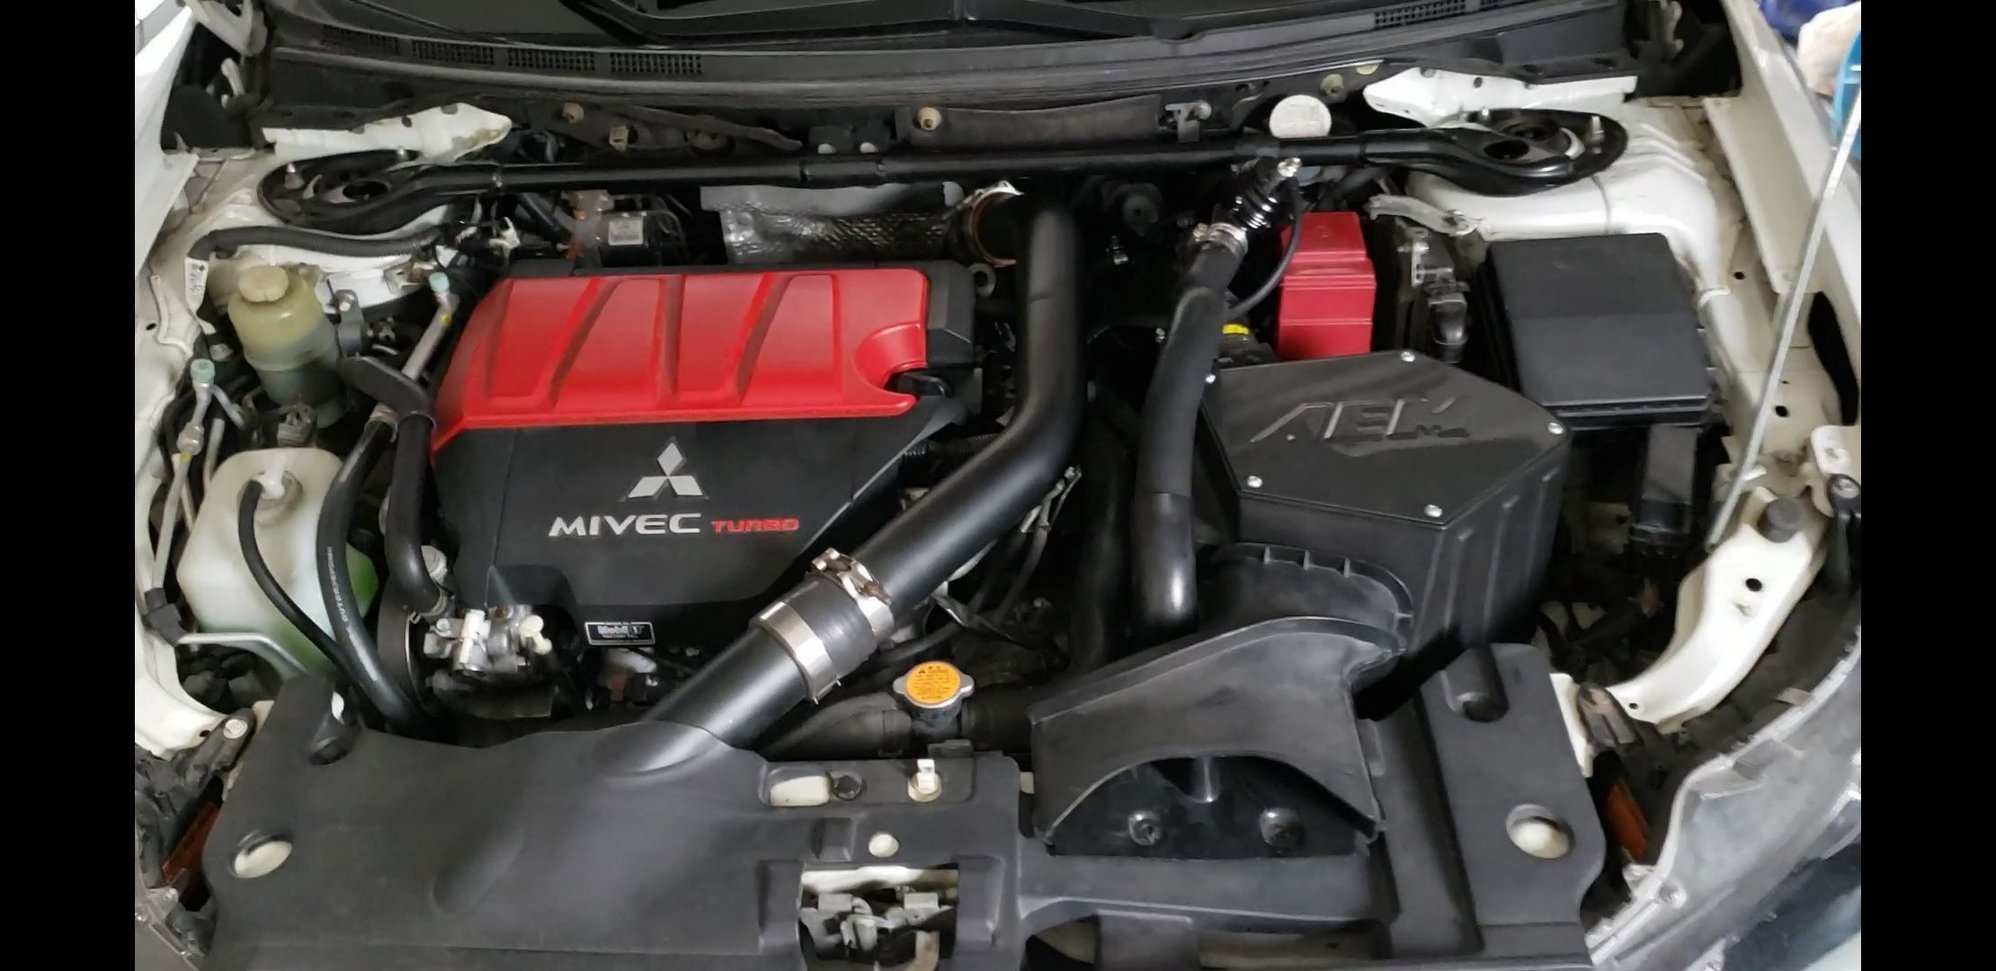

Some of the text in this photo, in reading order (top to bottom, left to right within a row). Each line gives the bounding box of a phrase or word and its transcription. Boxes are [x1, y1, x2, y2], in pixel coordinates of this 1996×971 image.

[1249, 397, 1471, 444] AEM
[548, 512, 800, 537] MIVEC TURBO
